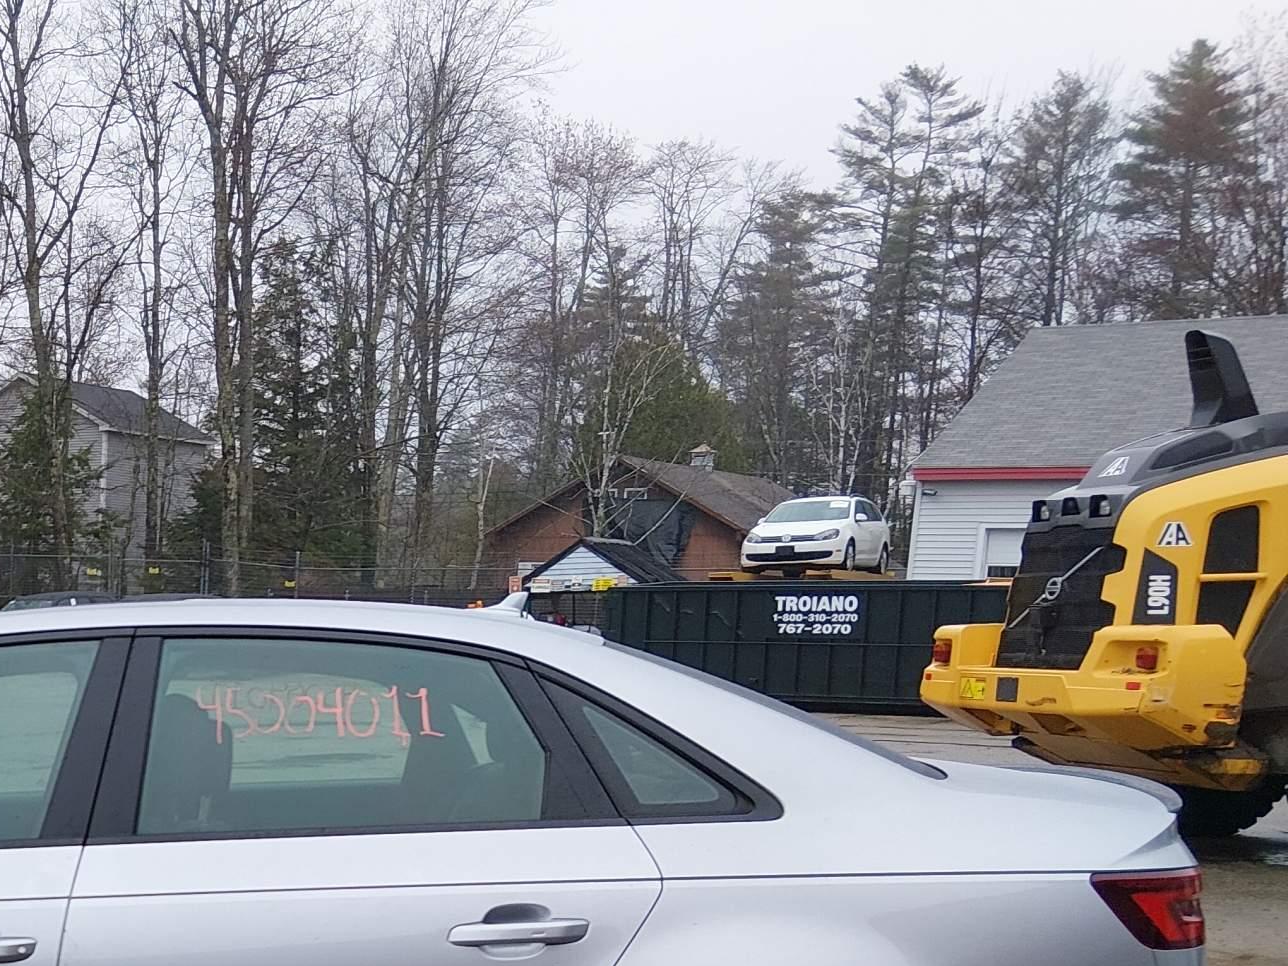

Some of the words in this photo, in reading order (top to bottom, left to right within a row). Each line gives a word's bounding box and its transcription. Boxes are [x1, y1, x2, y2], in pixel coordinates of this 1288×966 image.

[1146, 574, 1172, 615] L90H
[774, 595, 859, 612] TROIANO
[772, 613, 859, 622] 1-800-310-2070
[777, 623, 852, 634] 767-2070
